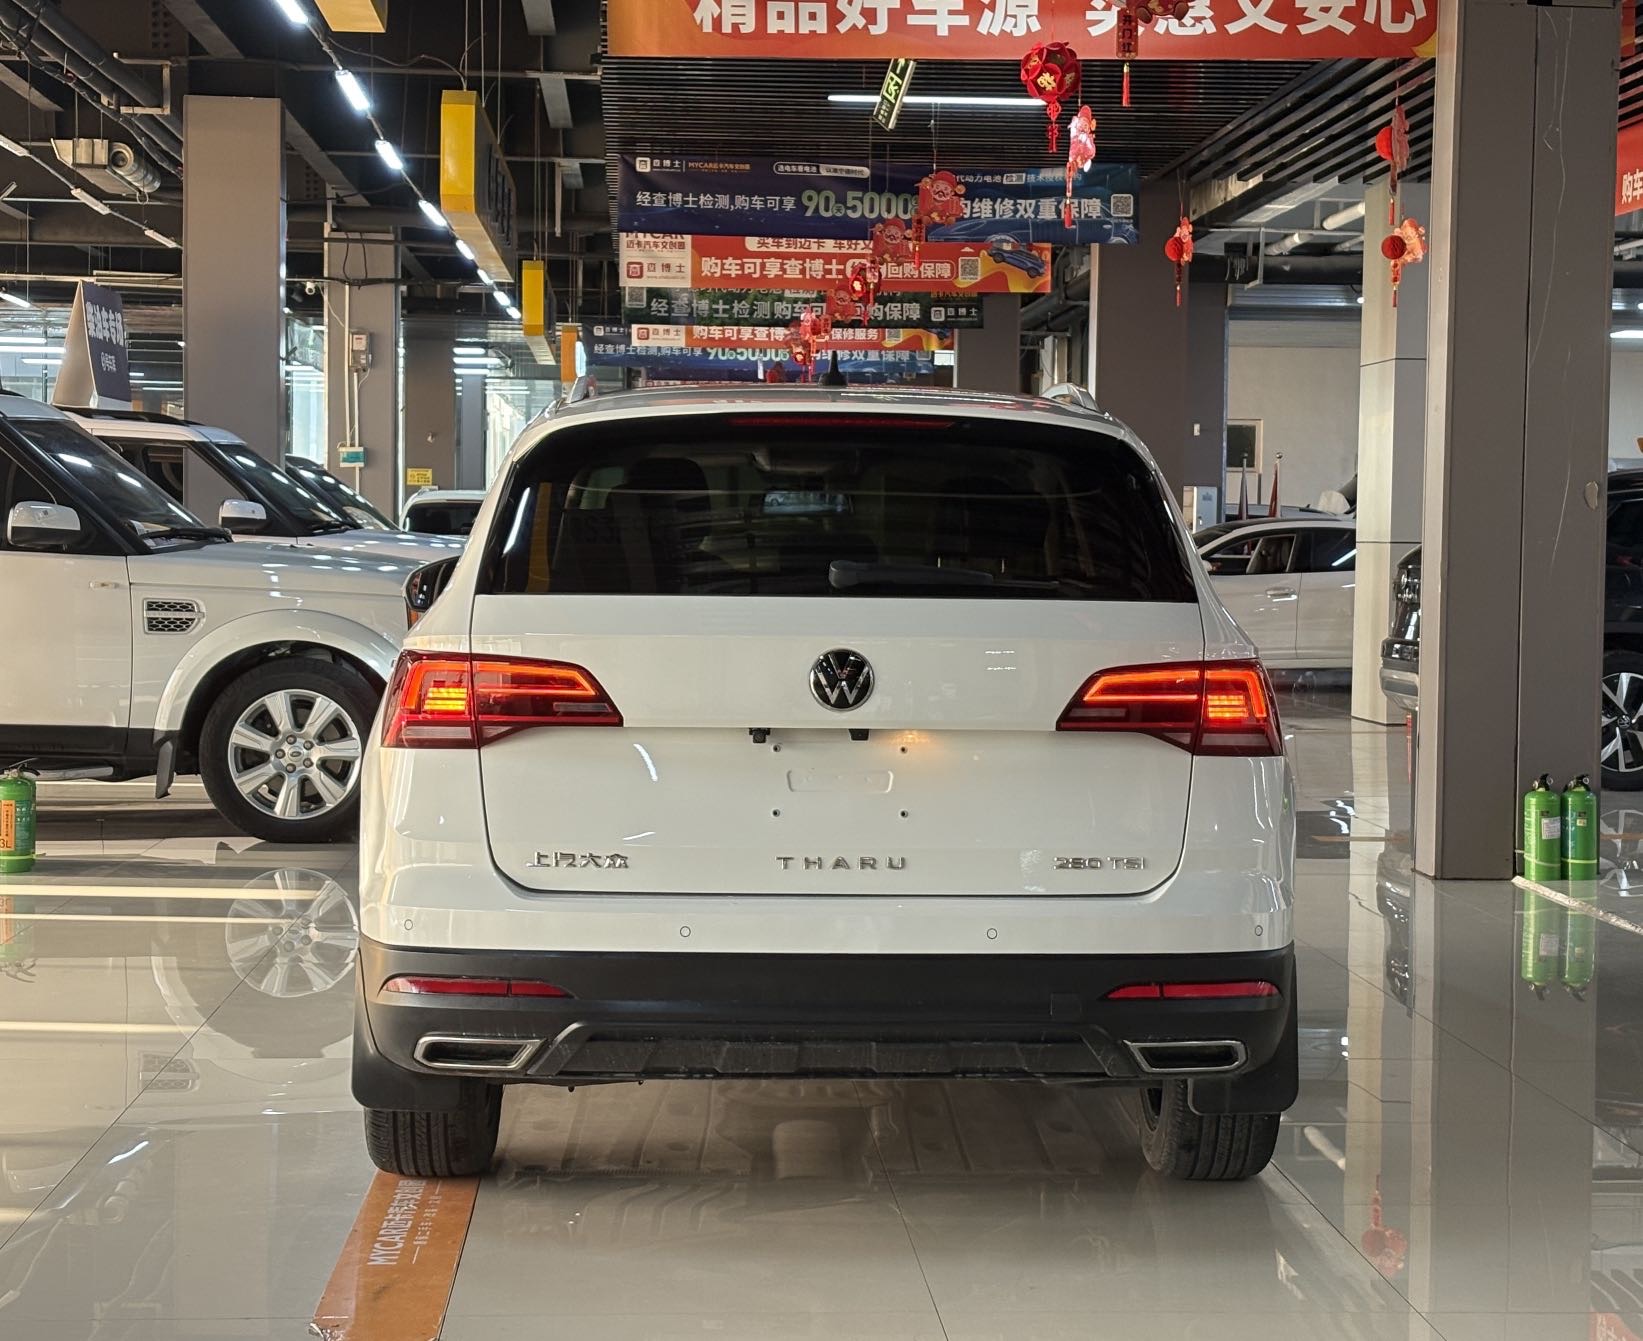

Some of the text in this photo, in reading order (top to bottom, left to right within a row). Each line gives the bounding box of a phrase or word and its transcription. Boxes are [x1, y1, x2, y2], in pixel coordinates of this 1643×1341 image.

[701, 256, 845, 280] 购车可享查博士
[526, 851, 629, 868] 上汽大众
[775, 856, 906, 870] THARU
[1106, 857, 1144, 870] TSI
